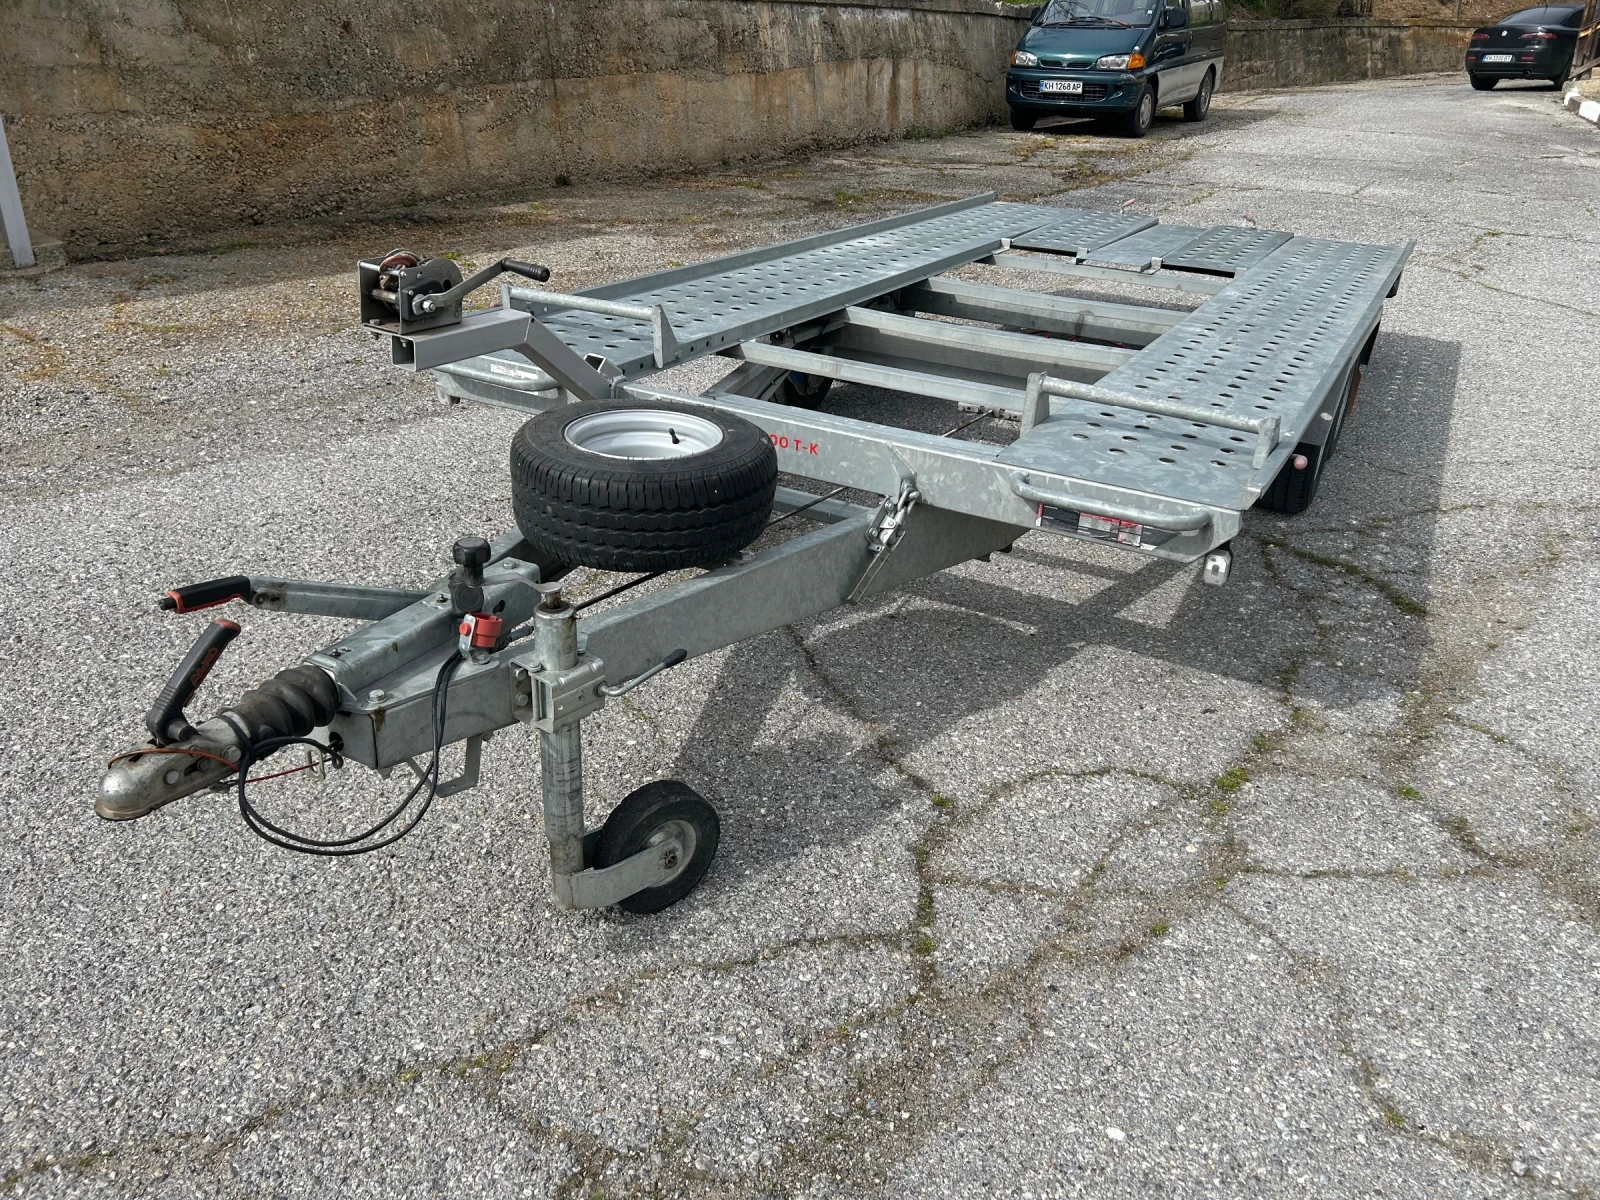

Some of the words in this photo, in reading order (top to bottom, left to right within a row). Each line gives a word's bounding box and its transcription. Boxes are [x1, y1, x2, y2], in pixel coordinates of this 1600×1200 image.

[1044, 82, 1054, 90] KH
[1055, 82, 1071, 91] 1268
[1071, 83, 1082, 91] AP
[793, 439, 819, 456] T-K
